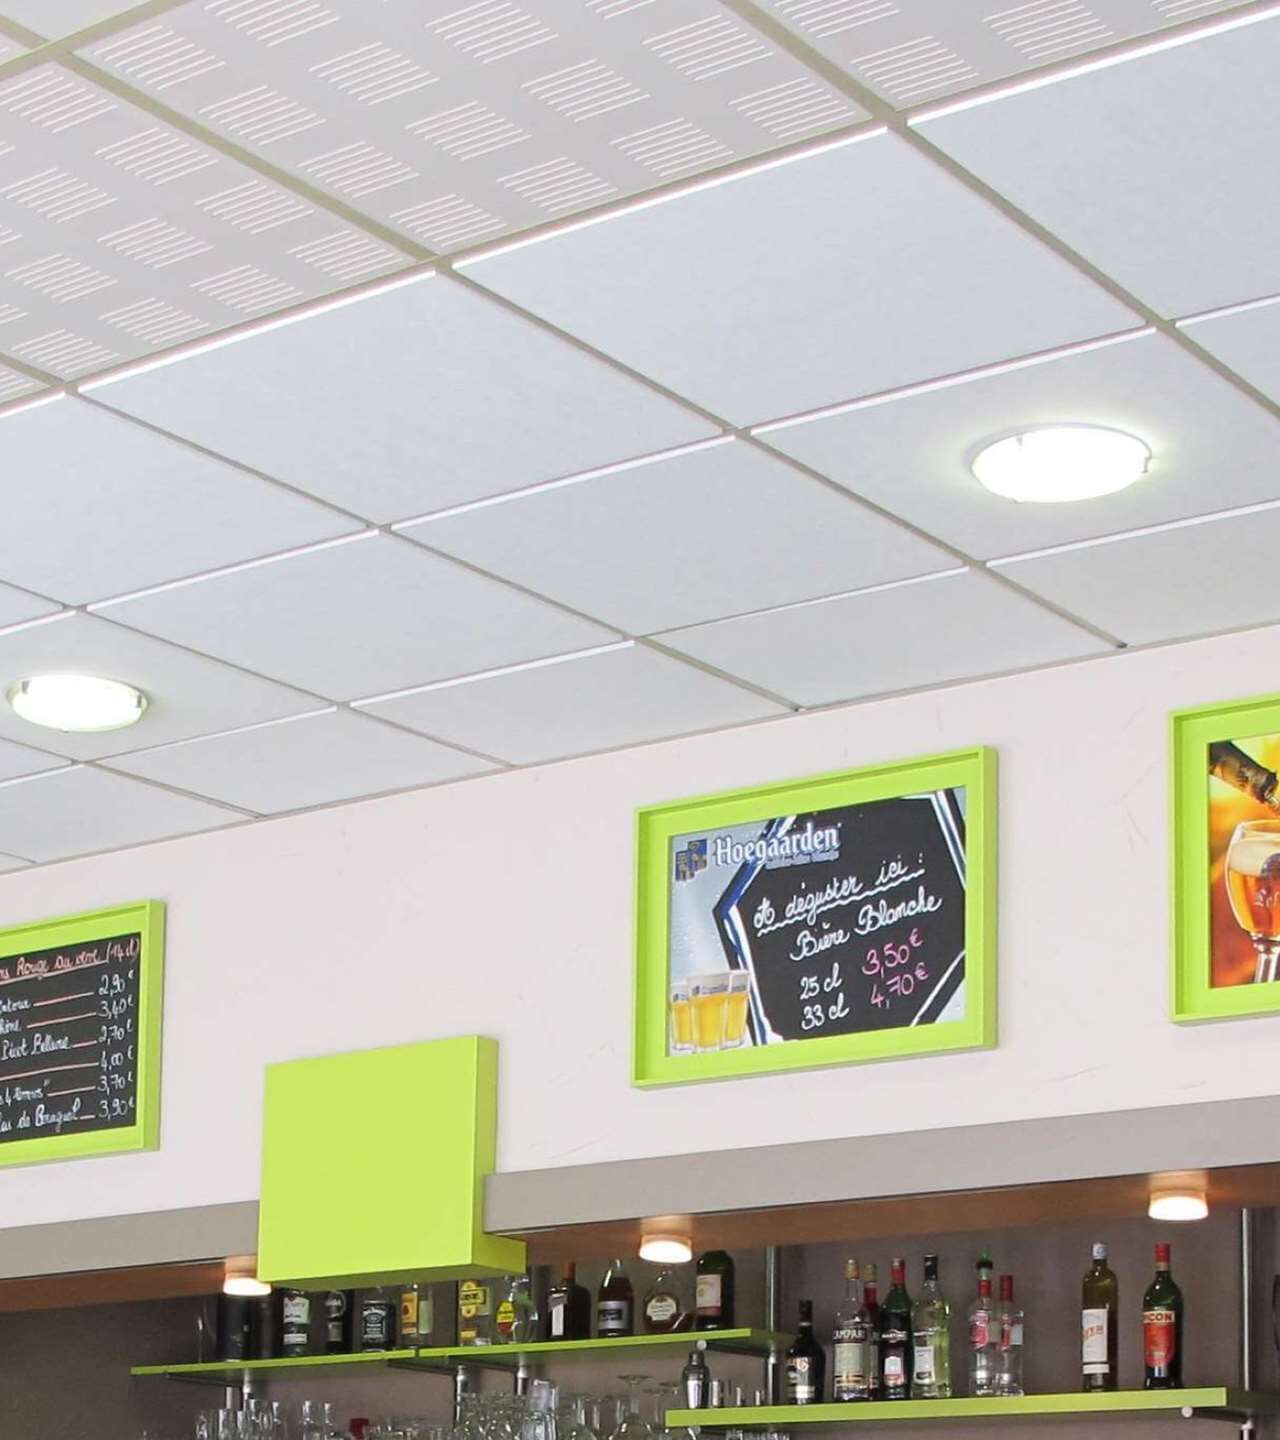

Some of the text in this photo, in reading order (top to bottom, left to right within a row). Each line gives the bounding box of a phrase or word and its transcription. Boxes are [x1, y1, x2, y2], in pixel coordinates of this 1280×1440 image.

[712, 824, 839, 868] Hoegaarden
[785, 874, 863, 927] déguster
[876, 855, 909, 887] ici
[790, 886, 942, 961] Bière Blanche
